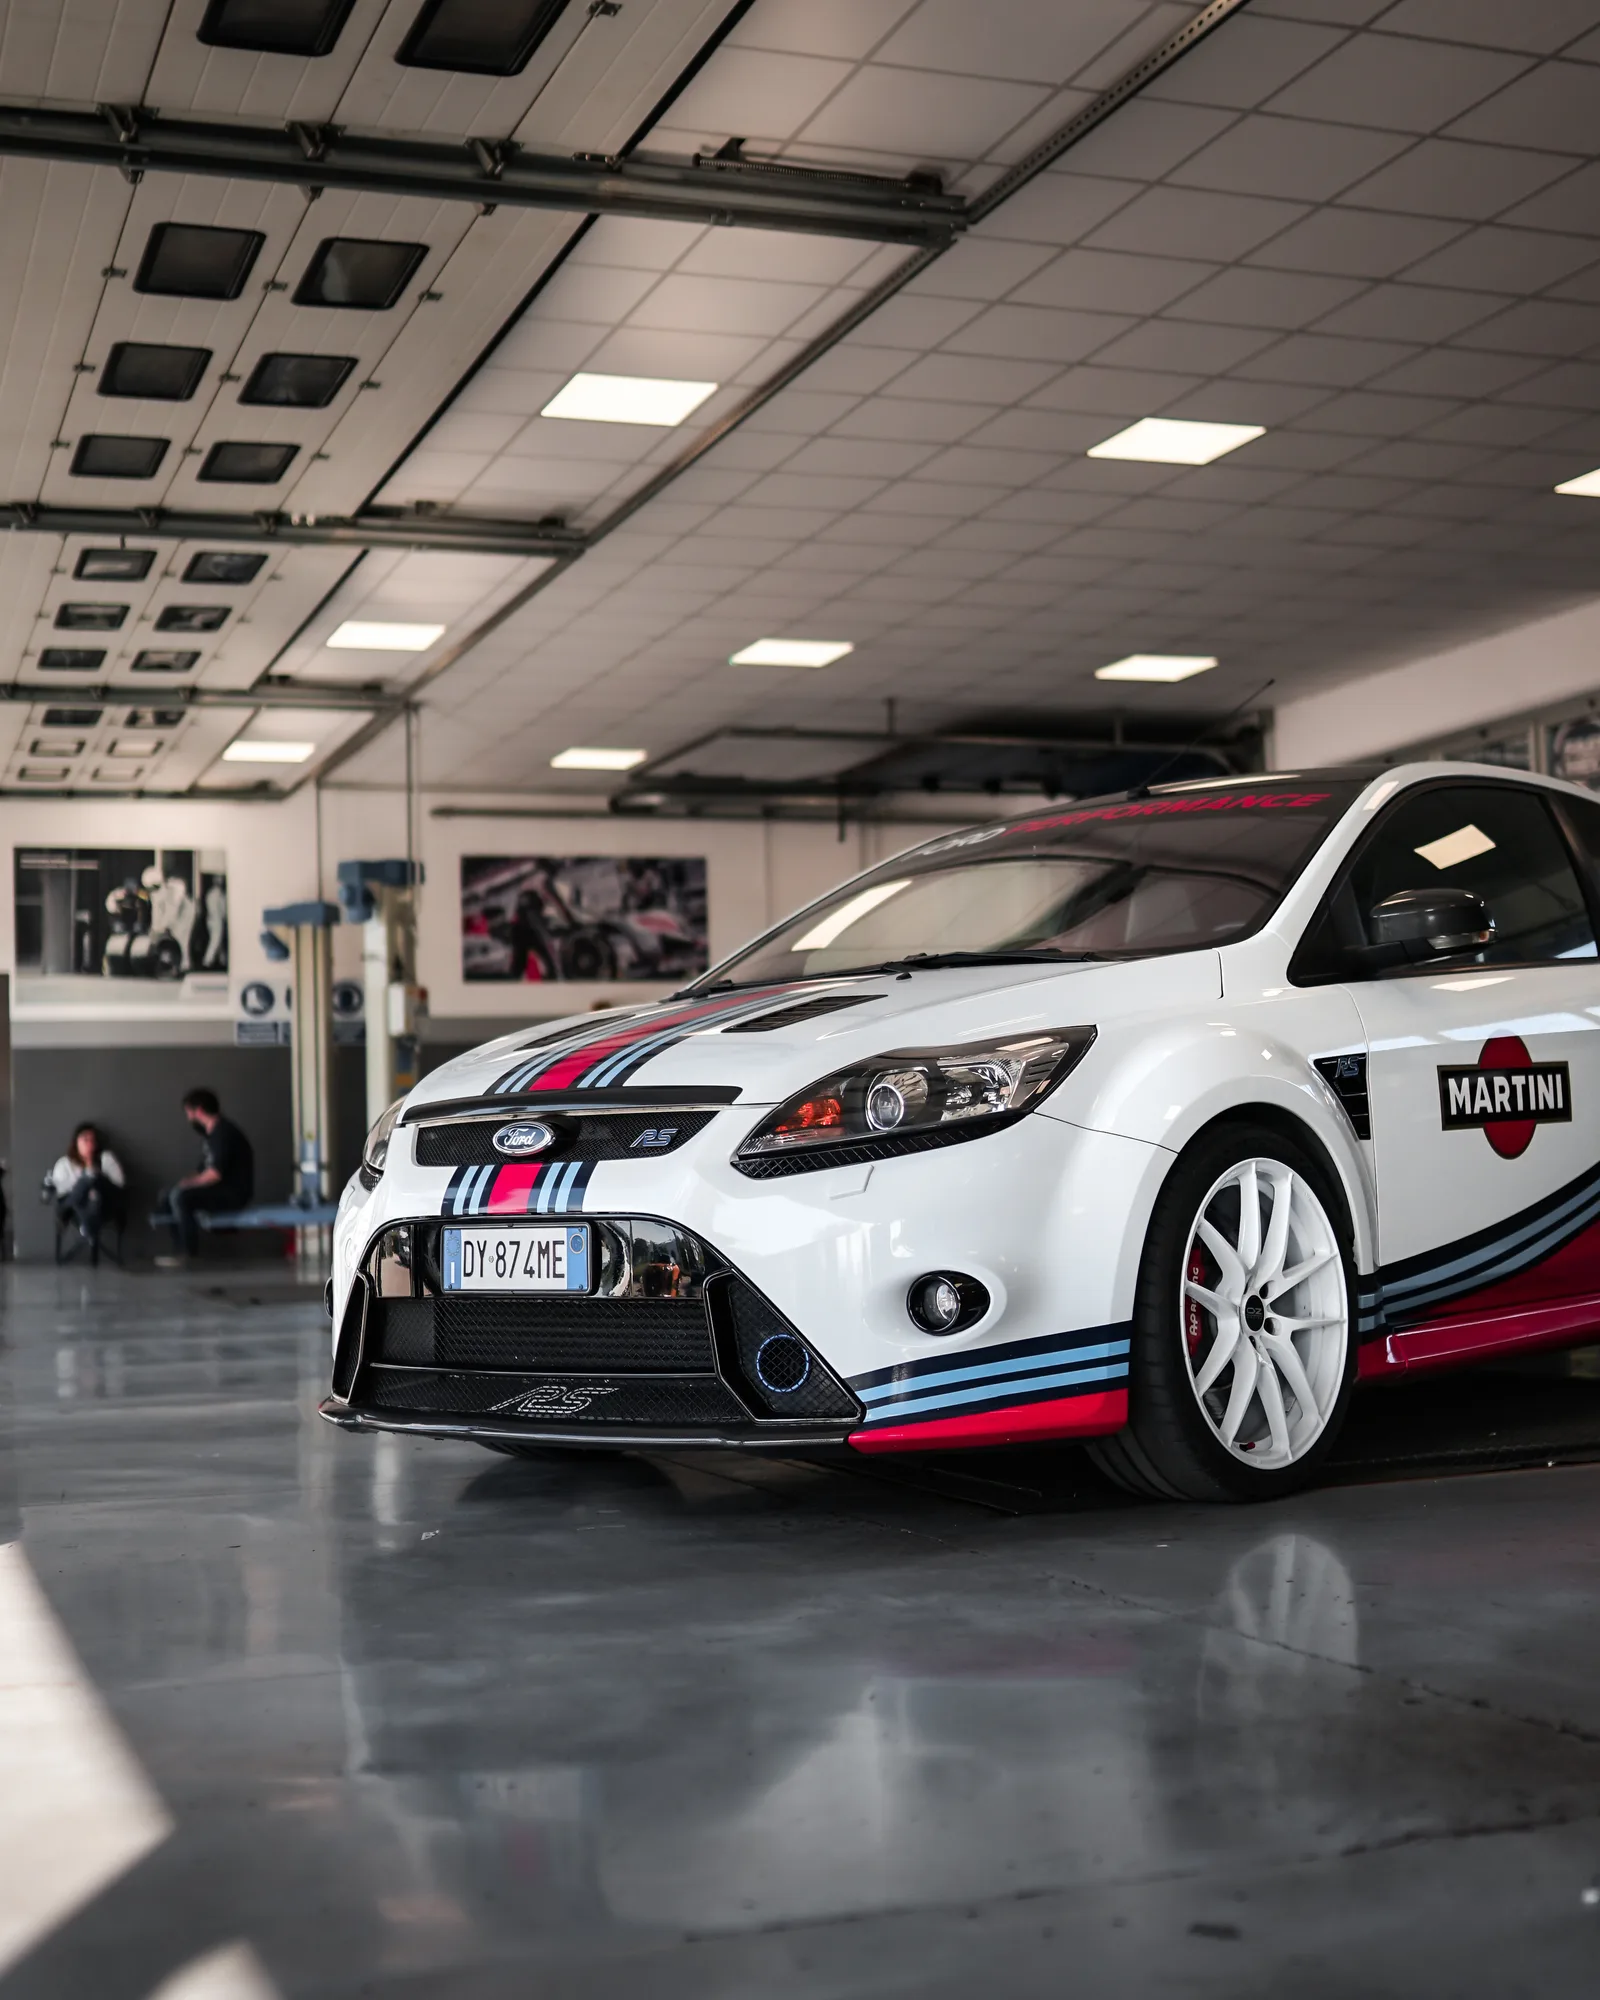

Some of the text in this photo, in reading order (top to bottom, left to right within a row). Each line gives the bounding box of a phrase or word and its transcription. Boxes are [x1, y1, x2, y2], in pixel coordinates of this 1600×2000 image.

[1001, 793, 1332, 837] PERFORMANCE
[1335, 1056, 1359, 1077] RS
[1448, 1073, 1564, 1116] MARTINI
[504, 1127, 536, 1146] Ford
[630, 1128, 678, 1148] RS
[487, 1385, 620, 1414] RS
